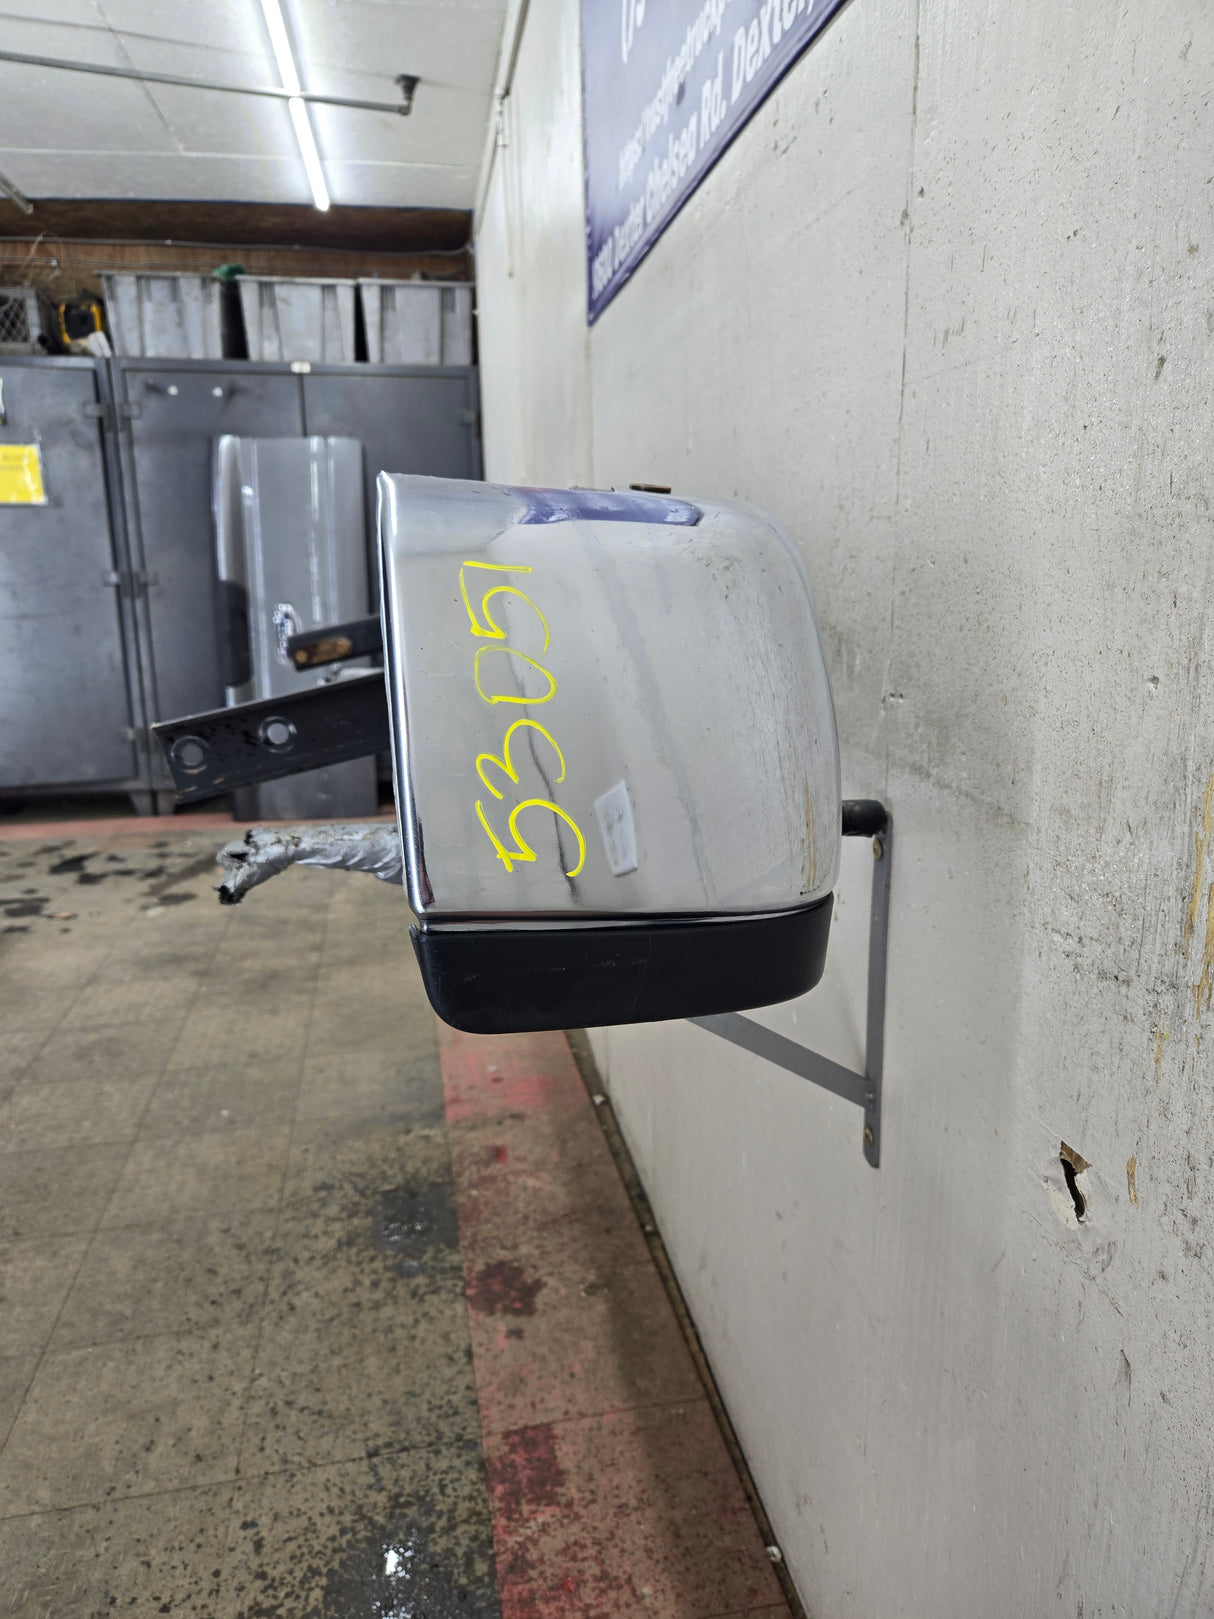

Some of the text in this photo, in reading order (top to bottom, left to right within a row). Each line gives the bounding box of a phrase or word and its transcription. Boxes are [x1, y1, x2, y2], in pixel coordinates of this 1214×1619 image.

[700, 51, 727, 149] Rd.
[731, 0, 815, 106] Dext,
[459, 560, 587, 878] 53051
